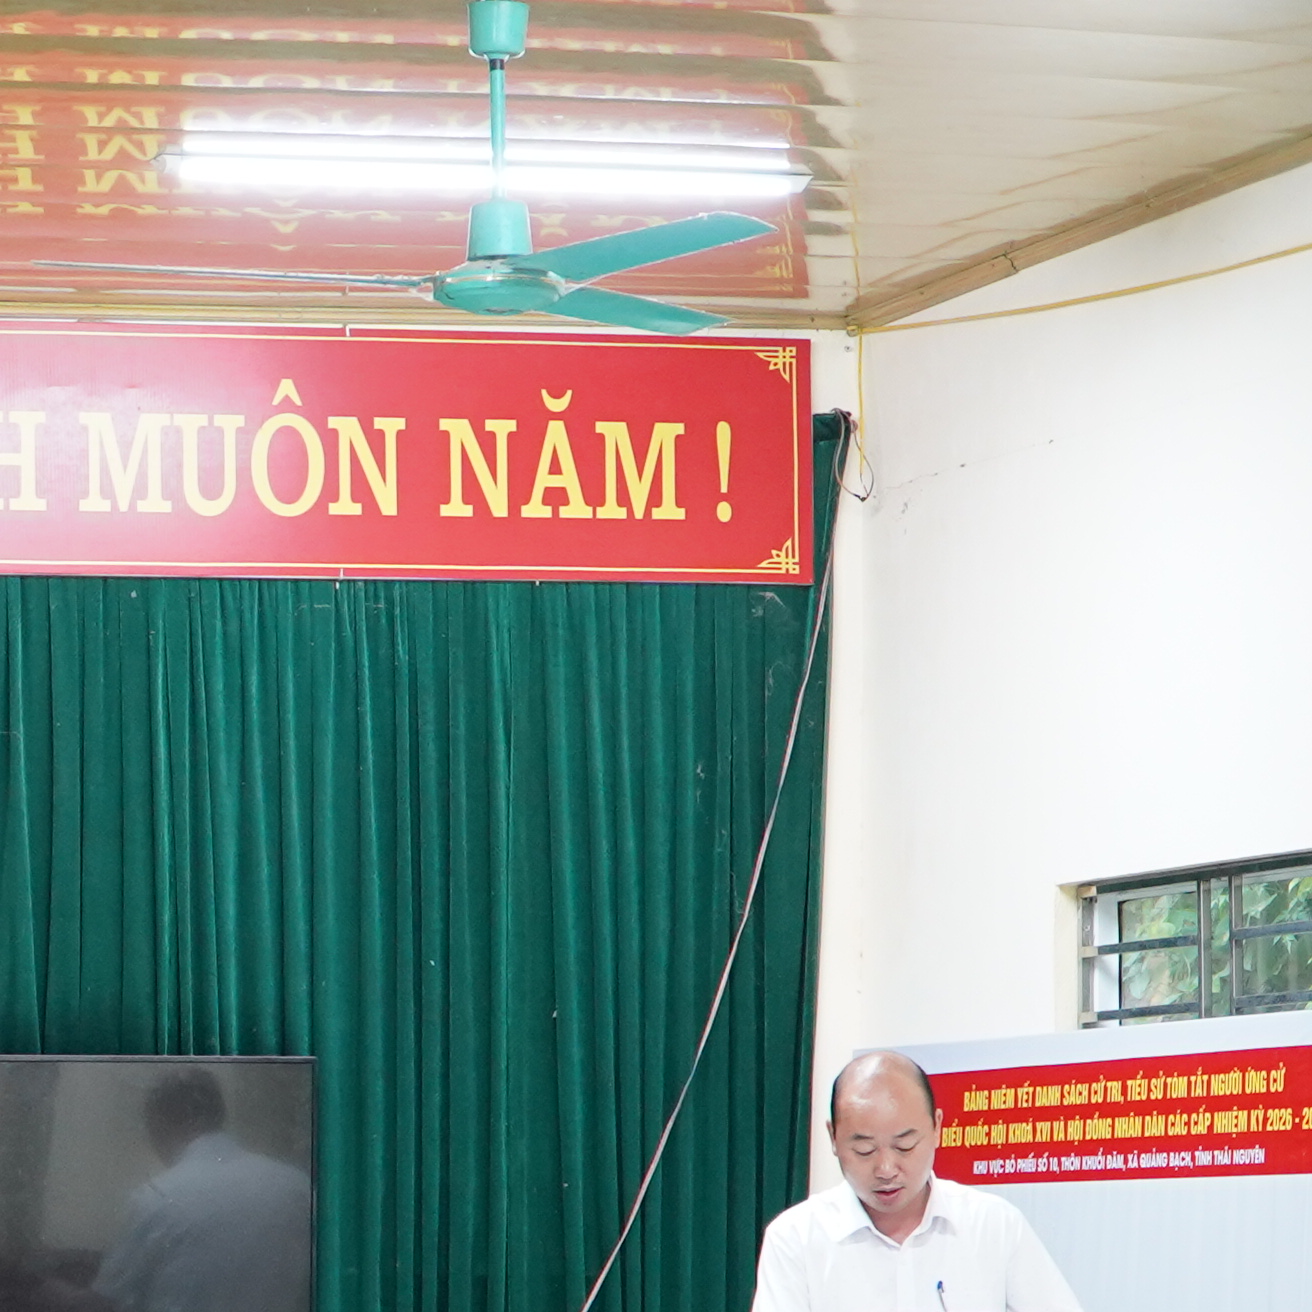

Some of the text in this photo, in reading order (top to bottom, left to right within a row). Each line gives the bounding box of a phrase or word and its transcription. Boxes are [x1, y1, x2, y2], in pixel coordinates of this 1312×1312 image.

[78, 378, 406, 517] MUÔN
[438, 388, 686, 520] NĂM
[715, 421, 733, 522] !
[963, 1084, 989, 1112] BẢNG
[990, 1084, 1016, 1110] NIÊM
[1017, 1080, 1035, 1109] YẾT
[1035, 1085, 1061, 1107] DANH
[1063, 1079, 1089, 1106] SÁCH
[1090, 1074, 1107, 1104] CỬ
[1149, 1070, 1166, 1100] SỬ
[1166, 1071, 1188, 1099] TÓM
[1189, 1066, 1209, 1098] TẮT
[1210, 1066, 1243, 1097] NGƯỜI
[1244, 1066, 1267, 1095] ỨNG
[1269, 1061, 1286, 1093] CỬ
[964, 1117, 989, 1149] QUỐC
[990, 1119, 1007, 1149] HỘI
[1008, 1118, 1033, 1144] KHOÁ
[1034, 1121, 1051, 1142] XVI
[1052, 1116, 1065, 1142] VÀ
[1066, 1115, 1084, 1146] HỘI
[1085, 1111, 1112, 1140] ĐỒNG
[1114, 1111, 1142, 1138] NHÂN
[1144, 1110, 1166, 1137] DÂN
[1167, 1109, 1188, 1136] CÁC
[1190, 1104, 1211, 1135] CẤP
[1213, 1105, 1248, 1138] NHIỆM
[1250, 1104, 1264, 1132] KỲ
[1266, 1107, 1293, 1131] 2026
